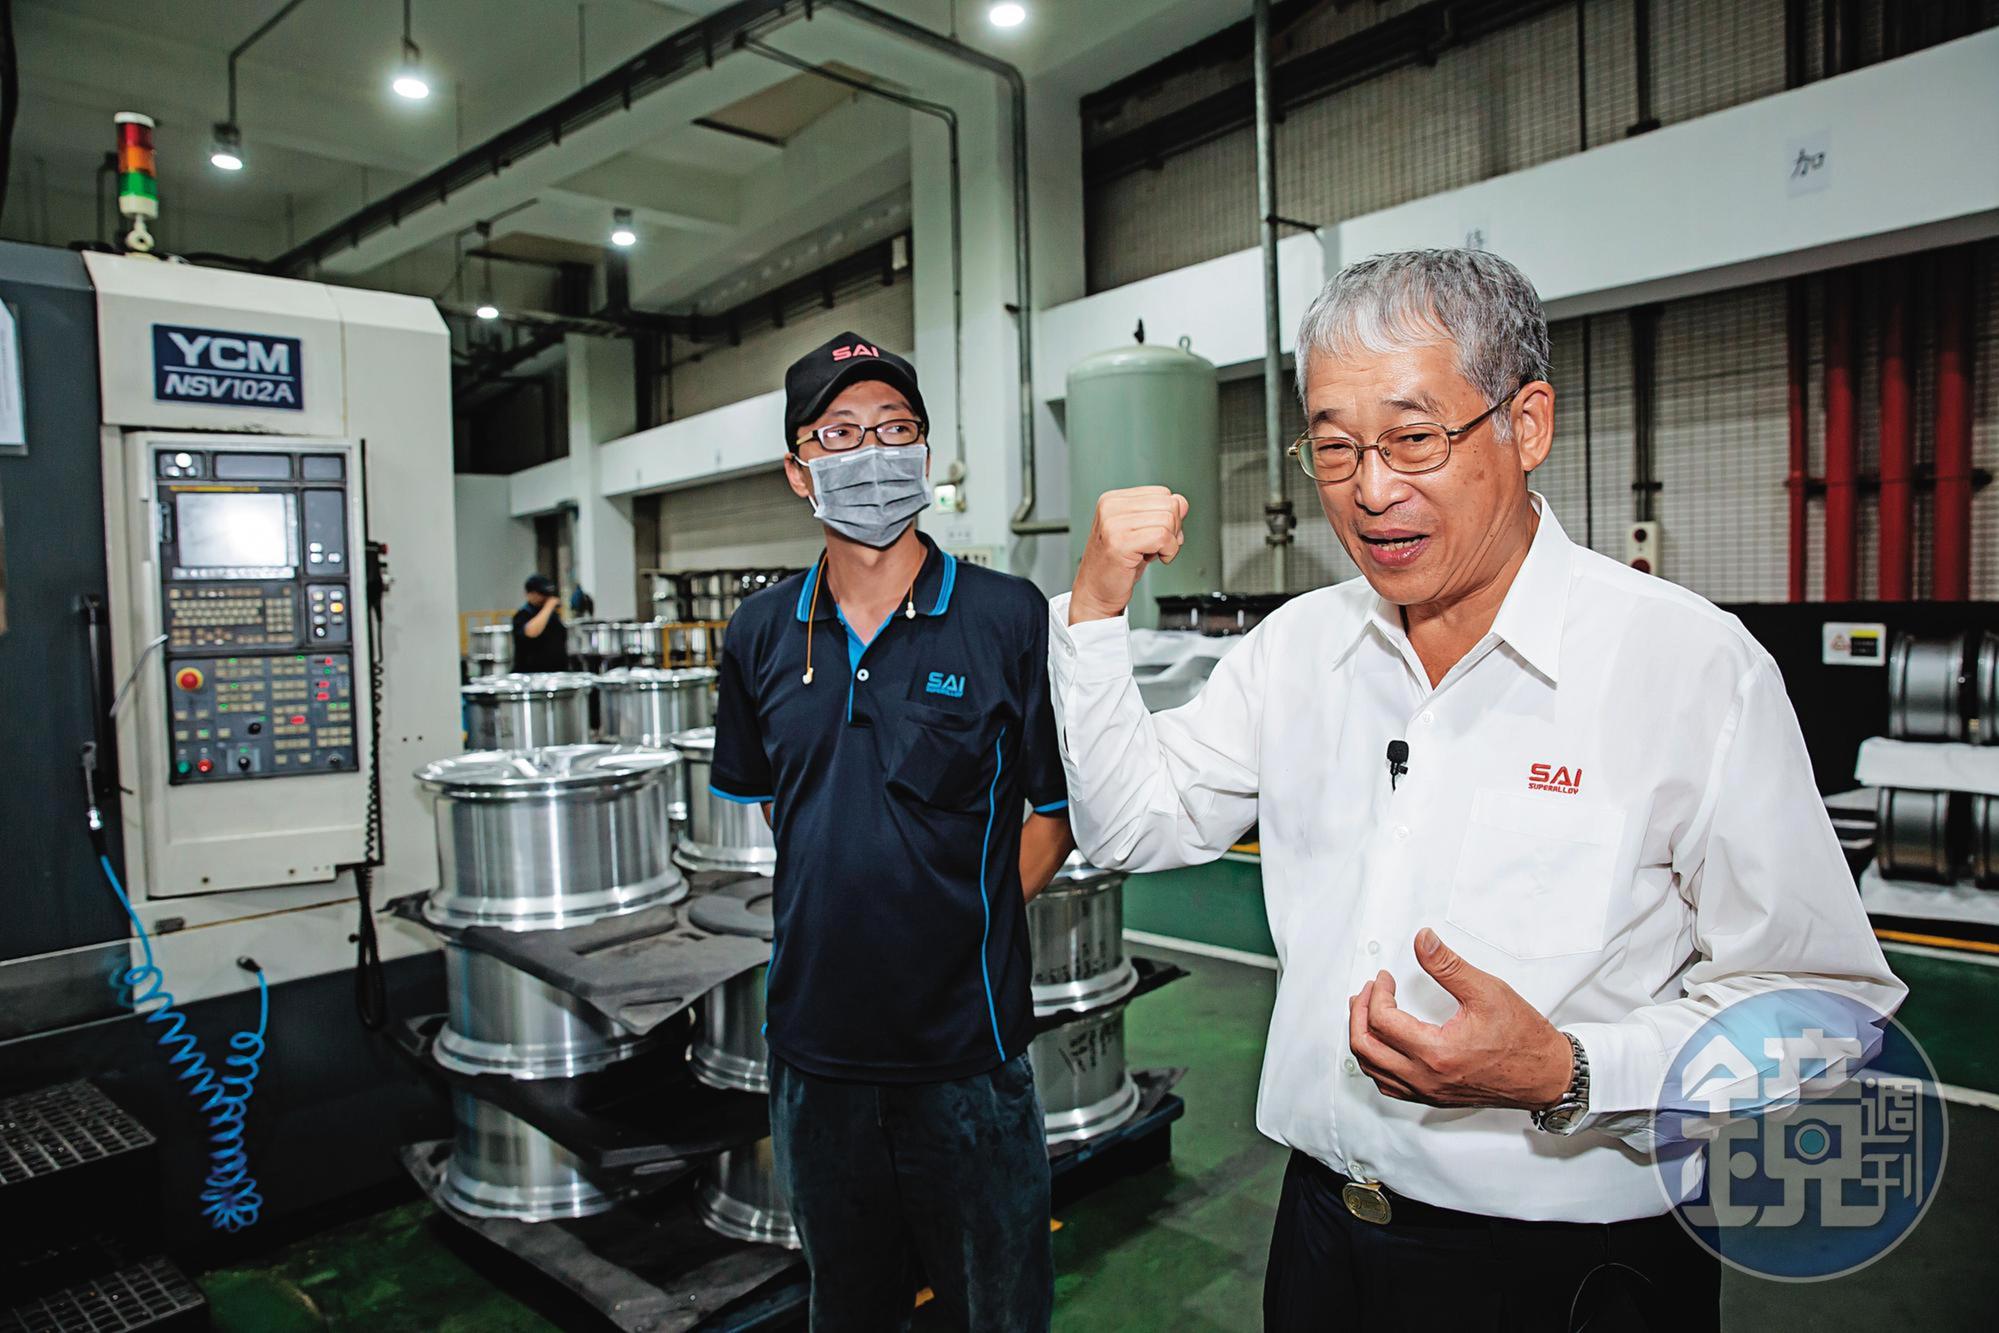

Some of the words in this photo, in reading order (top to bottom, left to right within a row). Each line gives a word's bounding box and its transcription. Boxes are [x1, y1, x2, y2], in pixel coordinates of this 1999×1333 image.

[168, 332, 290, 374] YCM
[832, 344, 880, 361] SAI
[164, 373, 295, 404] NSV102A
[927, 671, 966, 692] SAI
[1529, 763, 1582, 787] SAI
[1528, 783, 1579, 795] SUPERALLOY
